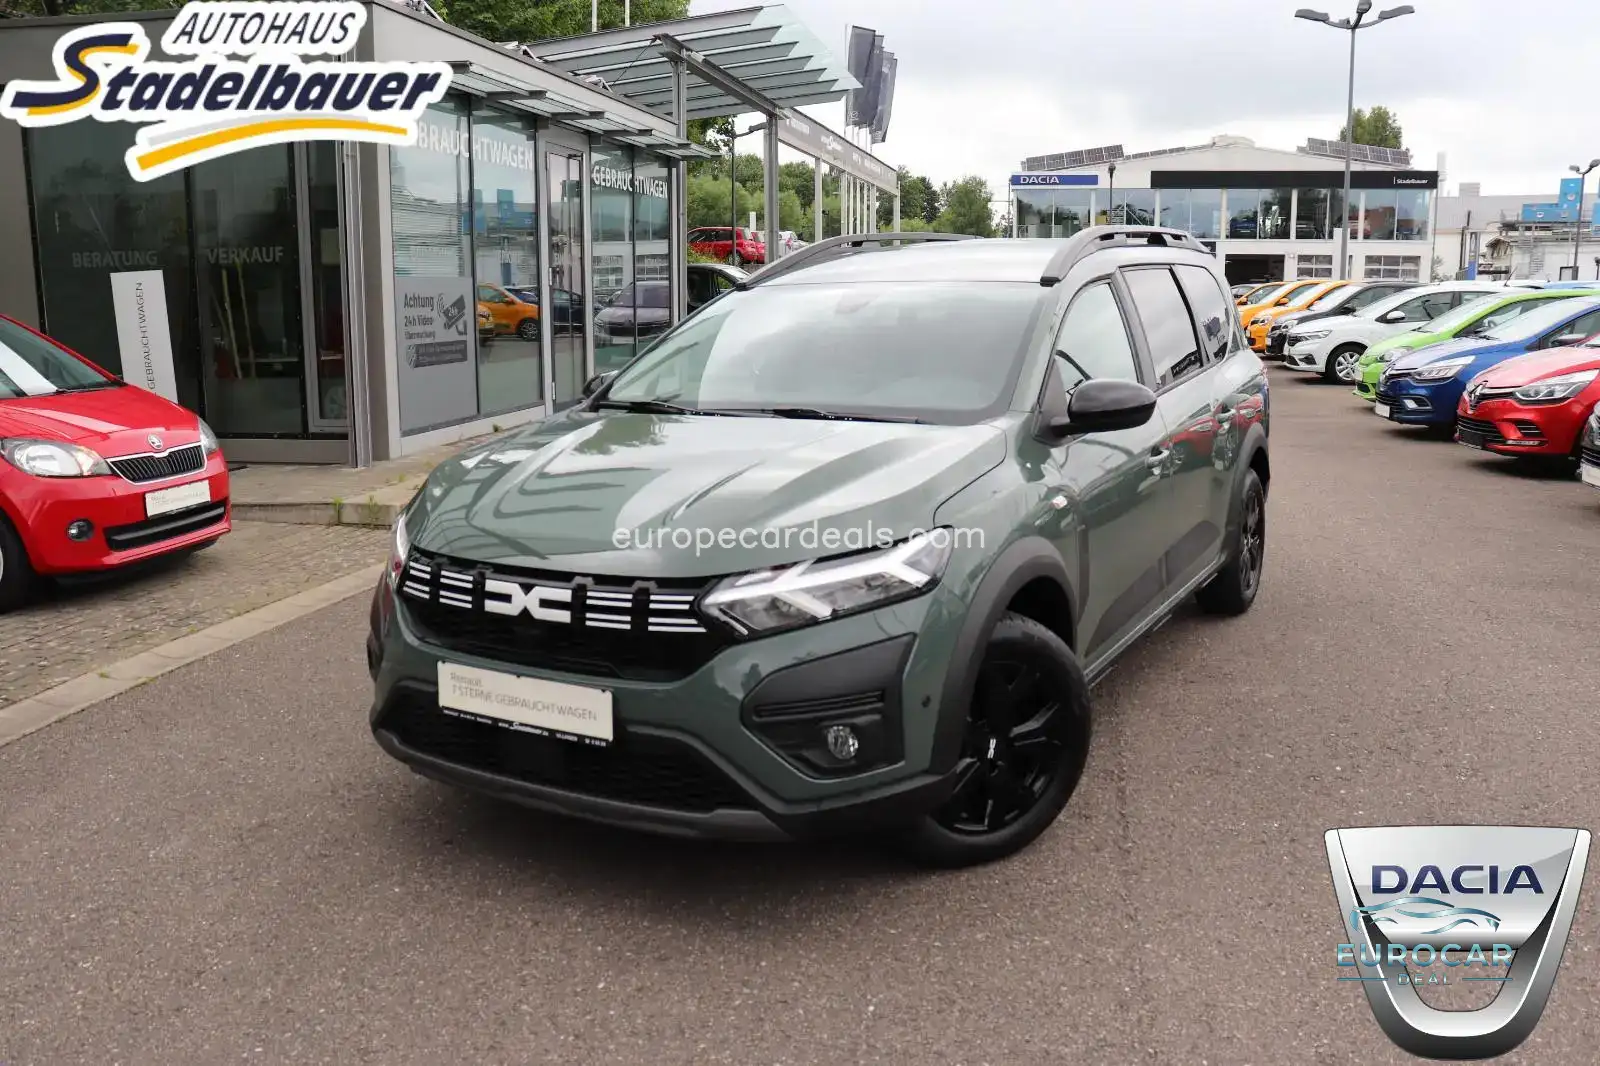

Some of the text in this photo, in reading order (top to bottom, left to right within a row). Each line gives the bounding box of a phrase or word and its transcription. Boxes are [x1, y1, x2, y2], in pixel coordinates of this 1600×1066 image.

[418, 121, 533, 170] BRAUCHTWAGEN
[1020, 176, 1060, 184] DACIA
[72, 250, 158, 268] BERATUNG
[207, 246, 284, 264] VERKAUF
[404, 292, 434, 311] Achtung
[135, 282, 156, 390] GEBRAUCHTWAGEN
[495, 694, 598, 721] GEBRAUCHTWAGEN
